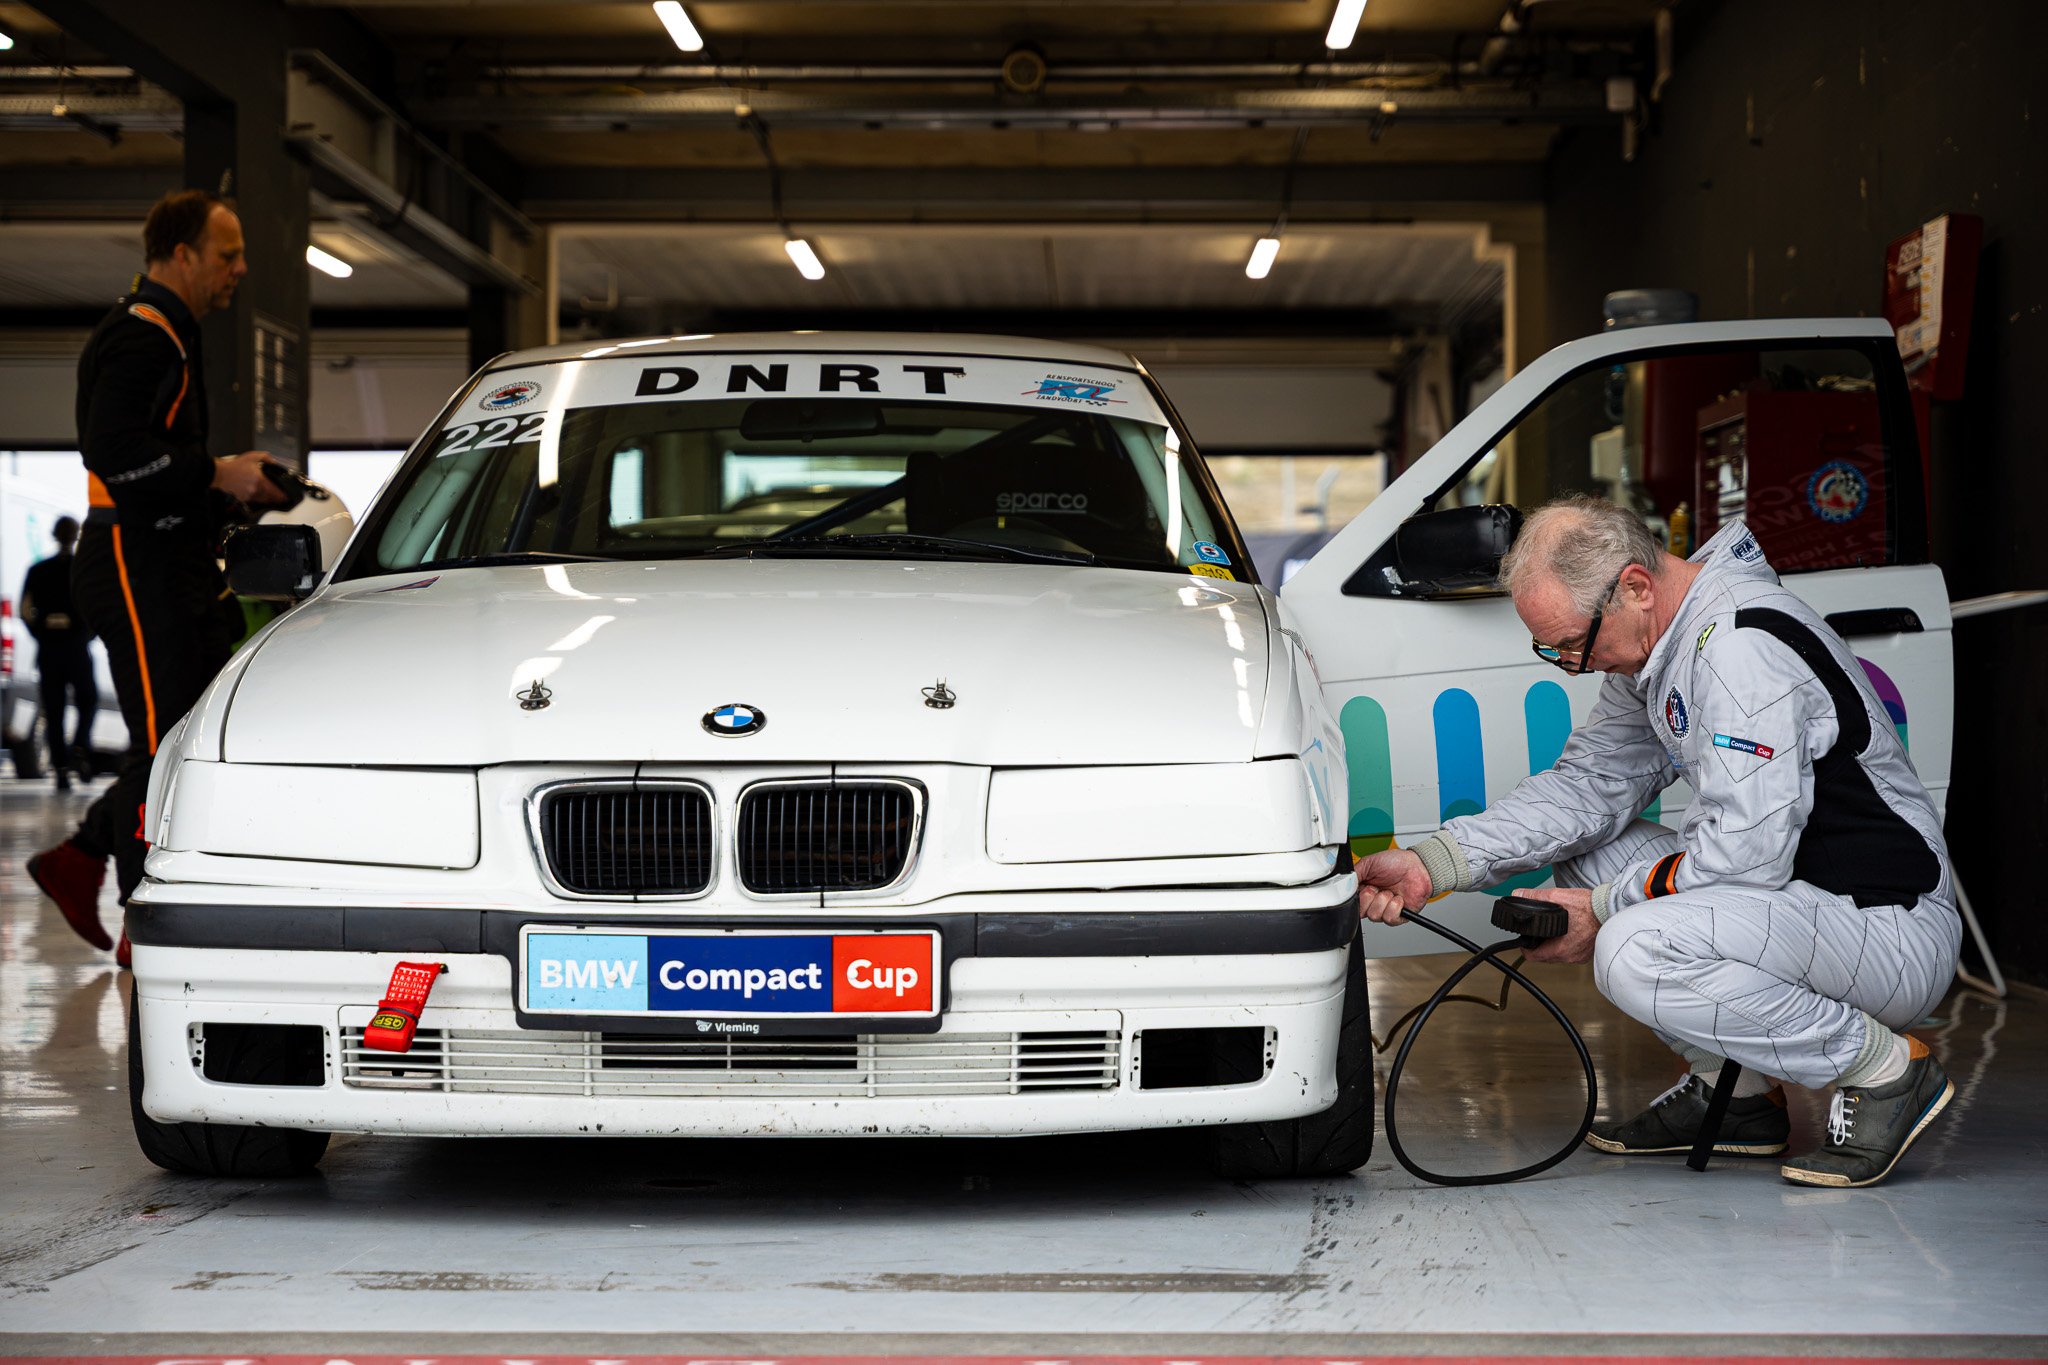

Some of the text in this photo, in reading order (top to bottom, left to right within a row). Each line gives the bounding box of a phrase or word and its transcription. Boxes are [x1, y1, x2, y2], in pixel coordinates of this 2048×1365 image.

[635, 363, 964, 396] DNRT
[436, 411, 548, 458] 222
[996, 492, 1088, 513] sparco
[1730, 740, 1756, 752] Compact
[1757, 747, 1771, 757] Cup
[539, 958, 919, 999] BMW Compact Cup
[373, 1016, 402, 1027] QSP
[714, 1022, 760, 1034] Vleming
